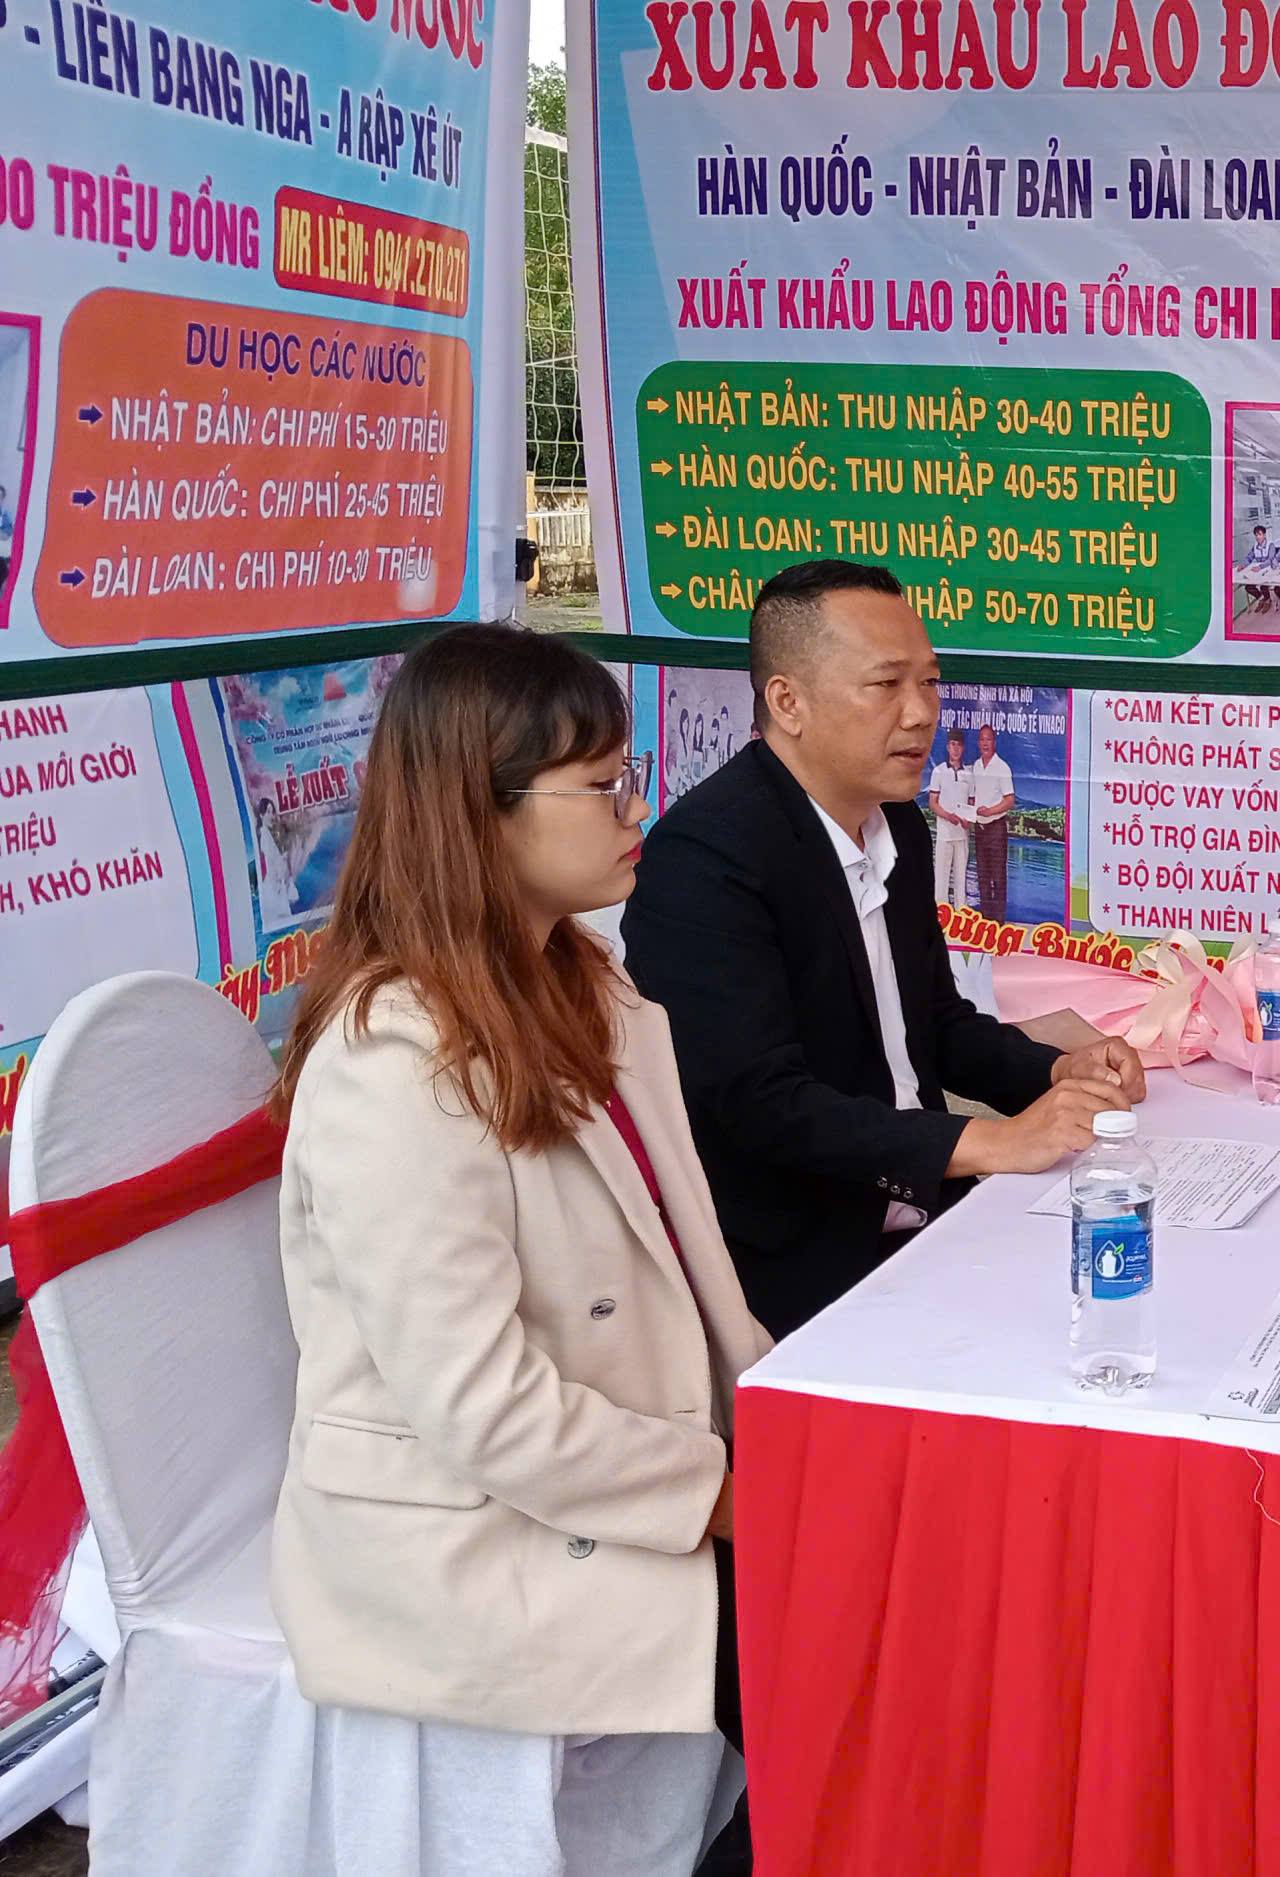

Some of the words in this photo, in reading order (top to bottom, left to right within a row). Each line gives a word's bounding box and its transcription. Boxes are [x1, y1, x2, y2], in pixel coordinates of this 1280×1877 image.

[1062, 0, 1199, 89] LAO
[149, 26, 244, 126] BANG
[249, 59, 312, 147] NGA
[337, 88, 352, 155] A
[359, 89, 403, 182] RẬP
[411, 104, 438, 182] XÊ
[442, 104, 463, 188] ÚT
[698, 144, 767, 216] HÀN
[780, 134, 872, 222] QUỐC
[909, 145, 1006, 229] NHẬT
[1017, 138, 1092, 219] BẢN
[1129, 145, 1189, 220] ĐÀI
[47, 163, 158, 263] TRIỆU
[280, 206, 311, 276] MR
[318, 204, 367, 286] LIÊM:
[373, 228, 466, 304] 0941.270.271
[677, 260, 765, 328] XUẤT
[779, 257, 874, 329] KHẨU
[887, 281, 952, 331] LAO
[965, 270, 1067, 345] ĐỘNG
[1080, 263, 1180, 338] TỔNG
[1195, 286, 1256, 340] CHI
[186, 323, 229, 368] DU
[238, 329, 301, 381] HỌC
[309, 331, 357, 380] CÁC
[362, 339, 426, 387] NƯỚC
[110, 389, 189, 452] NHẬT
[195, 387, 256, 445] BẢN:
[261, 407, 304, 447] CHI
[307, 402, 343, 448] PHÍ
[345, 413, 397, 451] 15-30
[401, 410, 448, 461] TRIỆU
[675, 383, 752, 433] NHẬT
[761, 378, 828, 428] BẢN:
[838, 393, 896, 429] THU
[906, 388, 986, 438] NHẬP
[997, 400, 1070, 436] 30-40
[1081, 393, 1171, 444] TRIỆU
[102, 467, 165, 522] HÀN
[171, 464, 248, 521] QUỐC:
[259, 484, 296, 519] CHI
[300, 470, 341, 519] PHÍ
[345, 484, 389, 519] 25-45
[397, 474, 444, 525] TRIỆU
[679, 444, 736, 488] HÀN
[746, 442, 835, 491] QUỐC:
[845, 457, 902, 494] THU
[914, 453, 993, 503] NHẬP
[1003, 465, 1078, 500] 40-55
[1086, 459, 1176, 510] TRIỆU
[92, 545, 142, 598] ĐÀI
[148, 551, 226, 595] LOAN:
[235, 551, 275, 591] CHI
[283, 540, 324, 588] PHÍ
[326, 548, 370, 585] 10-30
[683, 506, 728, 550] ĐÀI
[738, 517, 821, 553] LOAN:
[831, 520, 887, 556] THU
[898, 516, 977, 565] NHẬP
[987, 528, 1061, 563] 30-45
[1069, 523, 1158, 574] TRIỆU
[985, 591, 1059, 626] 50-70
[1068, 587, 1154, 637] TRIỆU
[1039, 714, 1065, 735] VINACO
[1221, 703, 1260, 728] CHI
[38, 752, 75, 791] MÔI
[80, 742, 137, 783] GIỚI
[1202, 740, 1262, 769] PHÁT
[1183, 786, 1224, 809] VAY
[1232, 779, 1278, 812] VỐN
[1150, 824, 1196, 854] TRỢ
[1203, 827, 1241, 851] GIA
[28, 858, 92, 906] KHÓ
[96, 847, 163, 892] KHĂN
[1118, 859, 1149, 892] BỘ
[1156, 861, 1193, 894] ĐỘI
[1200, 861, 1260, 893] XUẤT
[1117, 904, 1192, 930] THANH
[1201, 905, 1252, 933] NIÊN
